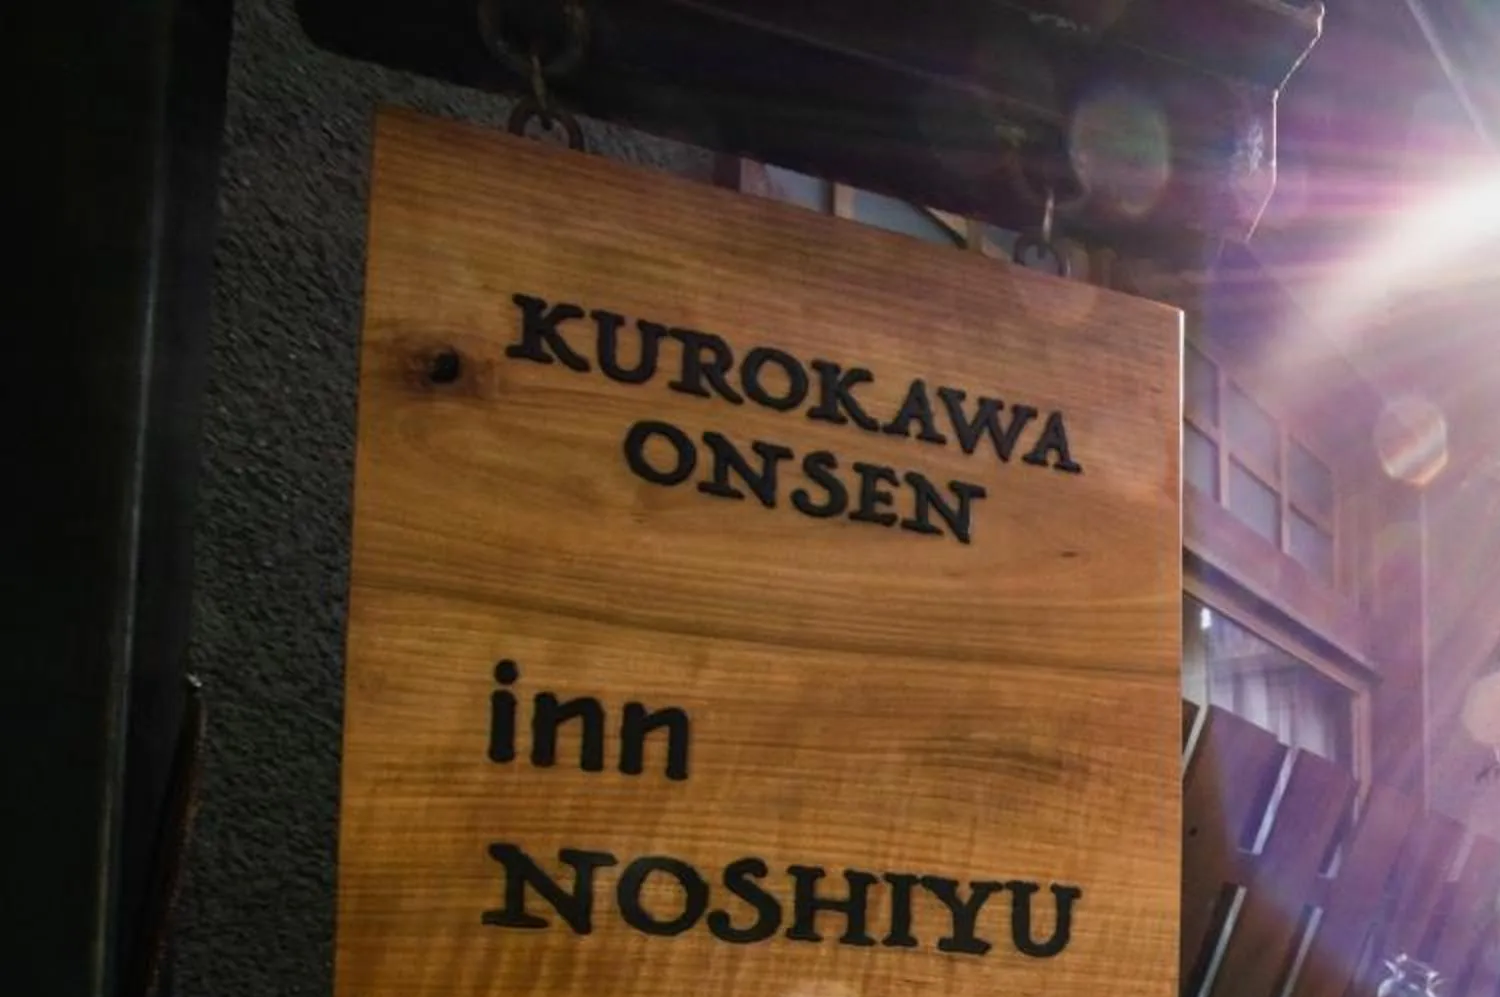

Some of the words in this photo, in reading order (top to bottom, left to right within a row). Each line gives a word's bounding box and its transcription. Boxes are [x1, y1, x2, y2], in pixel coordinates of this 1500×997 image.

[504, 292, 1082, 475] KUROKAWA
[620, 418, 988, 545] ONSEN
[486, 658, 693, 783] inn
[478, 840, 1082, 959] NOSHIYU
